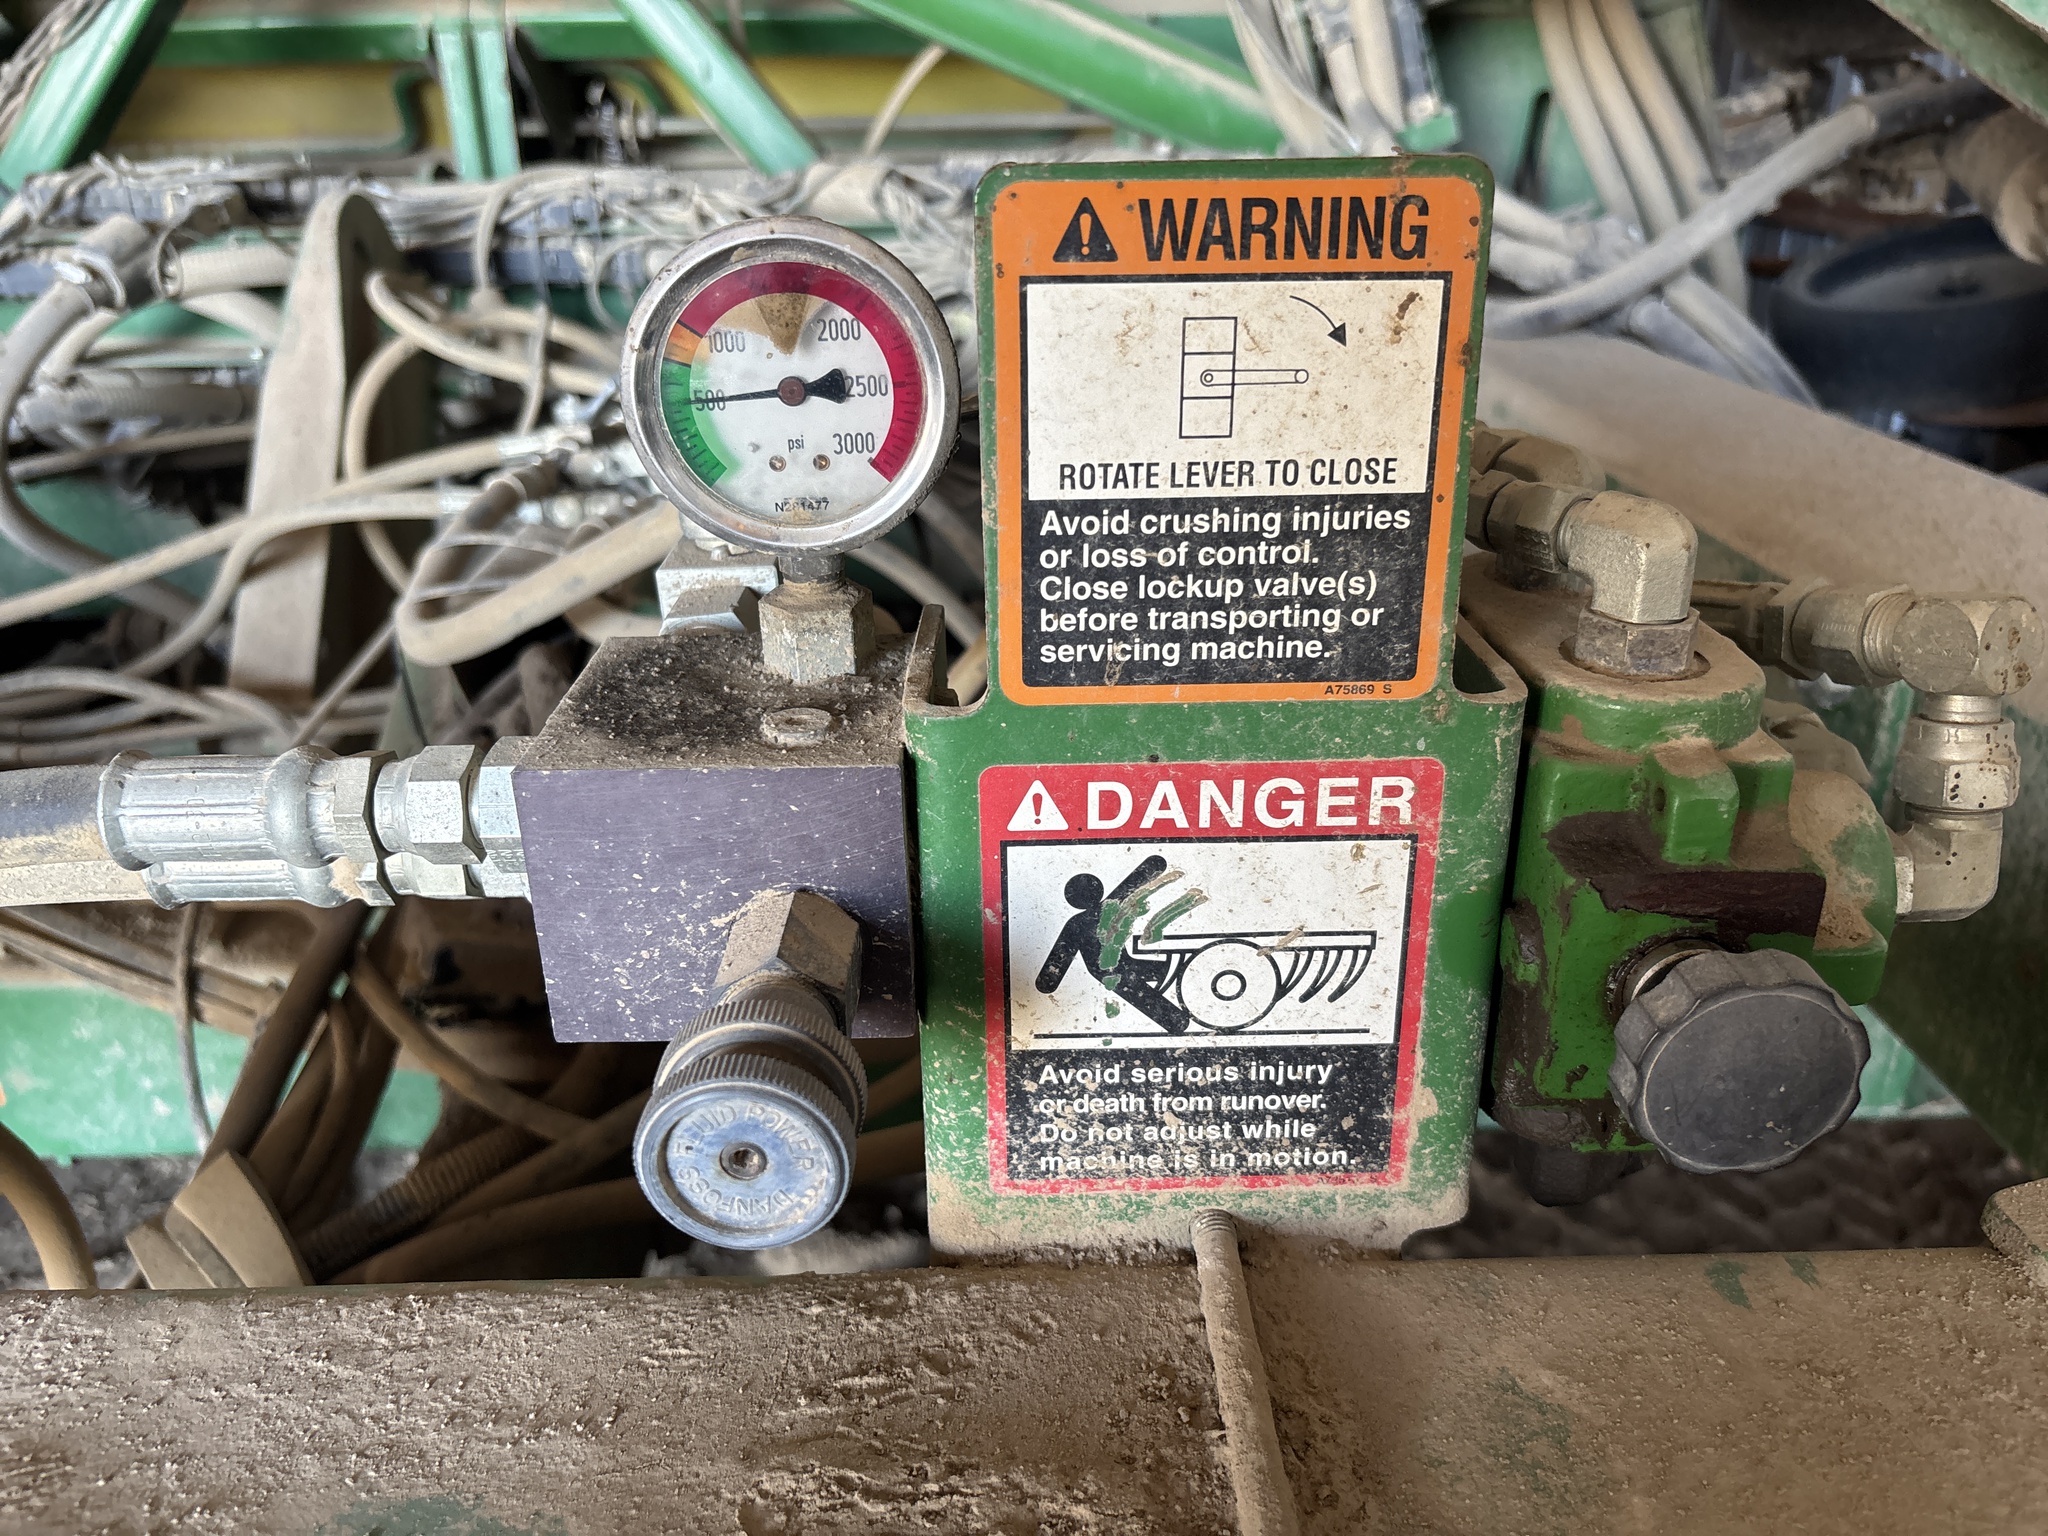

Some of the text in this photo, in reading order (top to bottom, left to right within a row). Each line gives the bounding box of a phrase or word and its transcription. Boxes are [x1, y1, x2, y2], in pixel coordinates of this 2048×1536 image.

[1138, 194, 1430, 262] WARNING
[707, 331, 746, 353] 1000
[817, 318, 861, 341] 2000
[845, 374, 889, 397] 2500
[693, 389, 726, 411] 500
[788, 435, 805, 452] psi
[833, 432, 876, 455] 3000
[1059, 457, 1398, 490] ROTATE LEVER TO CLOSE
[1040, 505, 1411, 538] Avoid crushing injuries
[1039, 539, 1319, 568] or loss of control.
[1040, 570, 1377, 604] Close lockup valve(s)
[1040, 604, 1384, 635] before transporting or
[1040, 635, 1331, 667] servicing machine.
[1324, 683, 1393, 696] A75869 S
[1087, 775, 1417, 830] DANGER
[1039, 1061, 1333, 1085] Avoid serious injury
[1038, 1093, 1327, 1114] or death from runover.
[675, 1101, 816, 1170] FLUID POWER
[1040, 1119, 1317, 1144] Do not adjust while
[1040, 1147, 1356, 1171] machine is in motion.
[677, 1164, 795, 1216] DANFOSS
